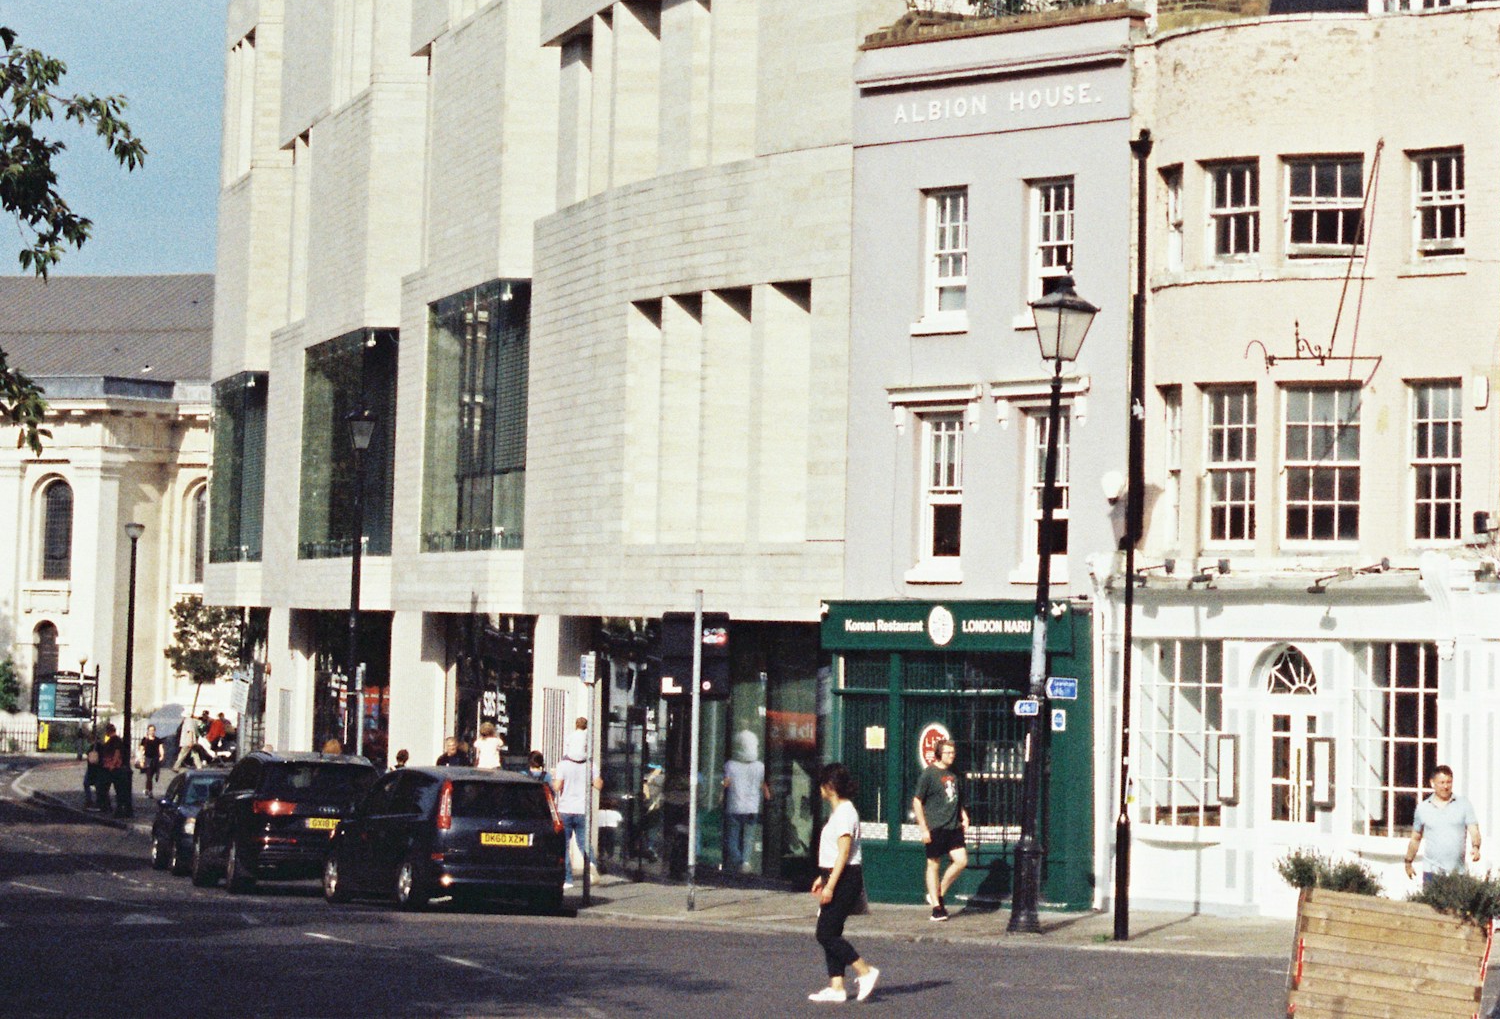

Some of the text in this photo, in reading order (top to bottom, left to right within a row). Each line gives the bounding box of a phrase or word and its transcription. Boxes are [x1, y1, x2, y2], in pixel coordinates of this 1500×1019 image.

[893, 82, 1102, 125] ALBION HOUSE.
[845, 619, 875, 632] Korean
[877, 619, 924, 633] Restaurant
[962, 619, 1003, 633] LONDON
[1004, 619, 1032, 633] NARU
